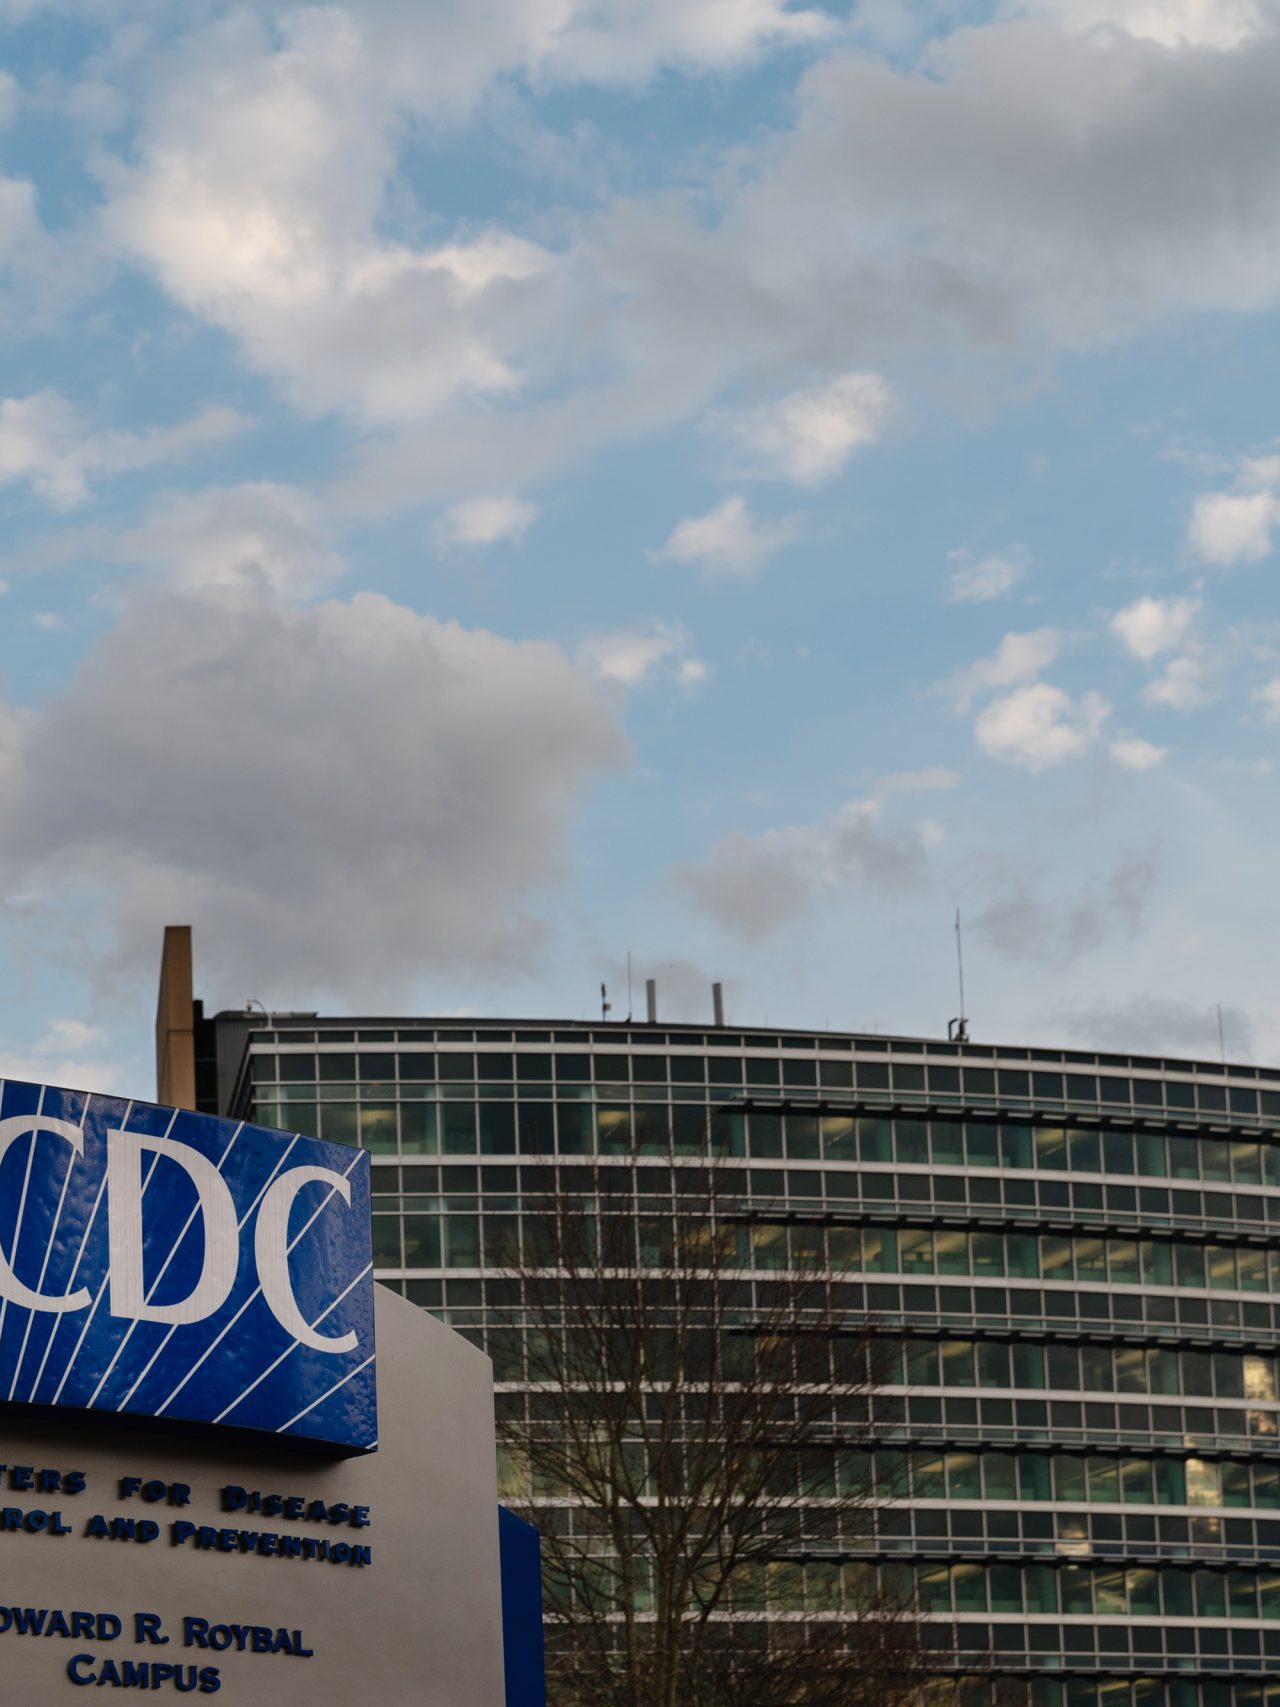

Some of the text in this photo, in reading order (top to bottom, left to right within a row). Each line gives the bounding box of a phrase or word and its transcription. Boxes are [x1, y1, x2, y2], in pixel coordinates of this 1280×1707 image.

[120, 1476, 191, 1505] FOR
[221, 1485, 371, 1527] DISEASE
[87, 1514, 160, 1543] AND
[174, 1521, 372, 1566] PREVENTION
[135, 1613, 170, 1645] R.
[183, 1616, 314, 1658] ROYBAL
[68, 1654, 221, 1693] CAMPUS
